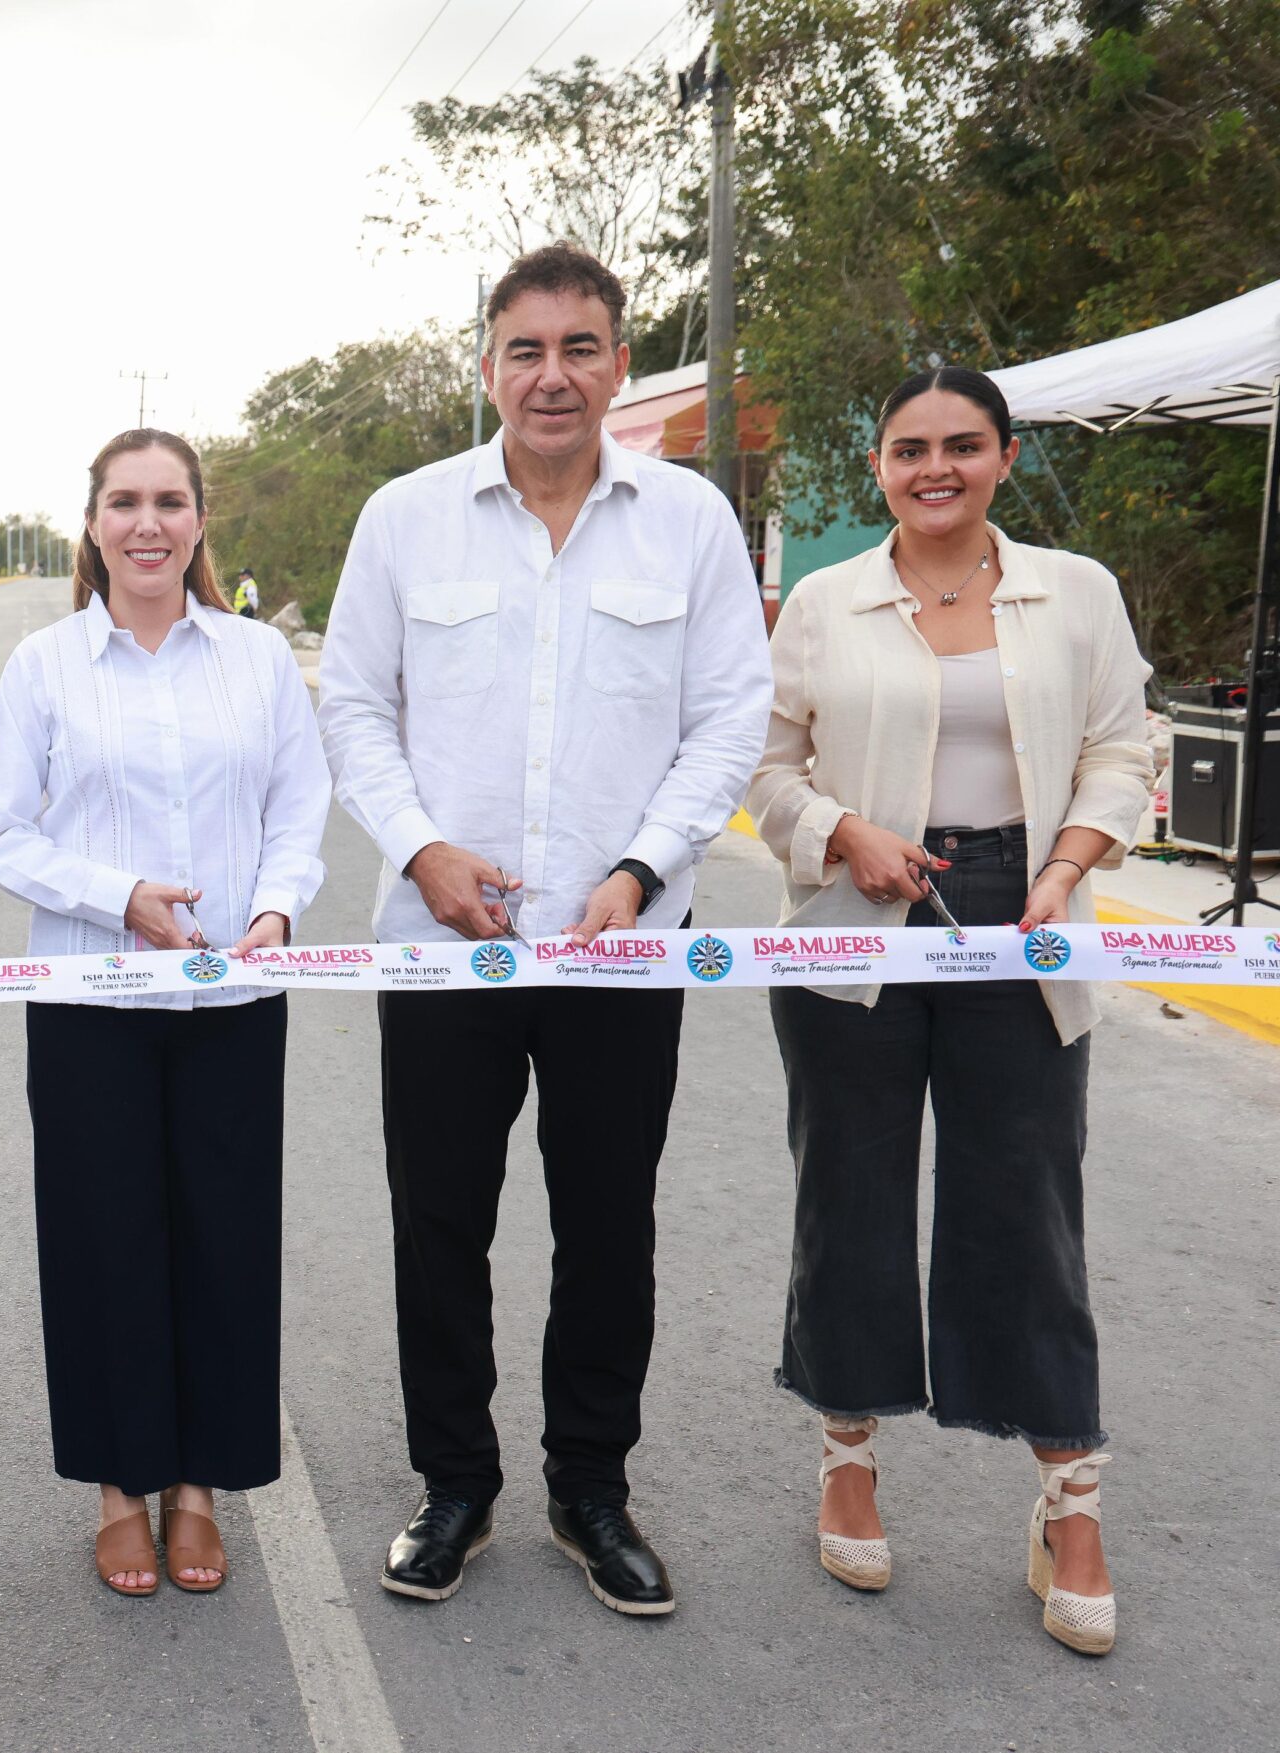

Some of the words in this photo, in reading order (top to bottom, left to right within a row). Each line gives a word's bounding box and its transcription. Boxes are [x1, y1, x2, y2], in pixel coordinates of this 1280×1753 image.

[582, 940, 666, 958] MUJERES
[799, 936, 886, 954] MUJERES
[1148, 933, 1236, 952] MUJERES
[287, 949, 374, 963] MUJERES
[1122, 956, 1156, 970] Sigamos
[1159, 958, 1222, 970] Transformando
[261, 968, 296, 979] Sigamos
[298, 968, 360, 978] Transformando
[556, 964, 588, 976] Sigamos
[591, 964, 650, 976] Transformando
[771, 962, 806, 976] Sigamos
[808, 962, 872, 972] Transformando
